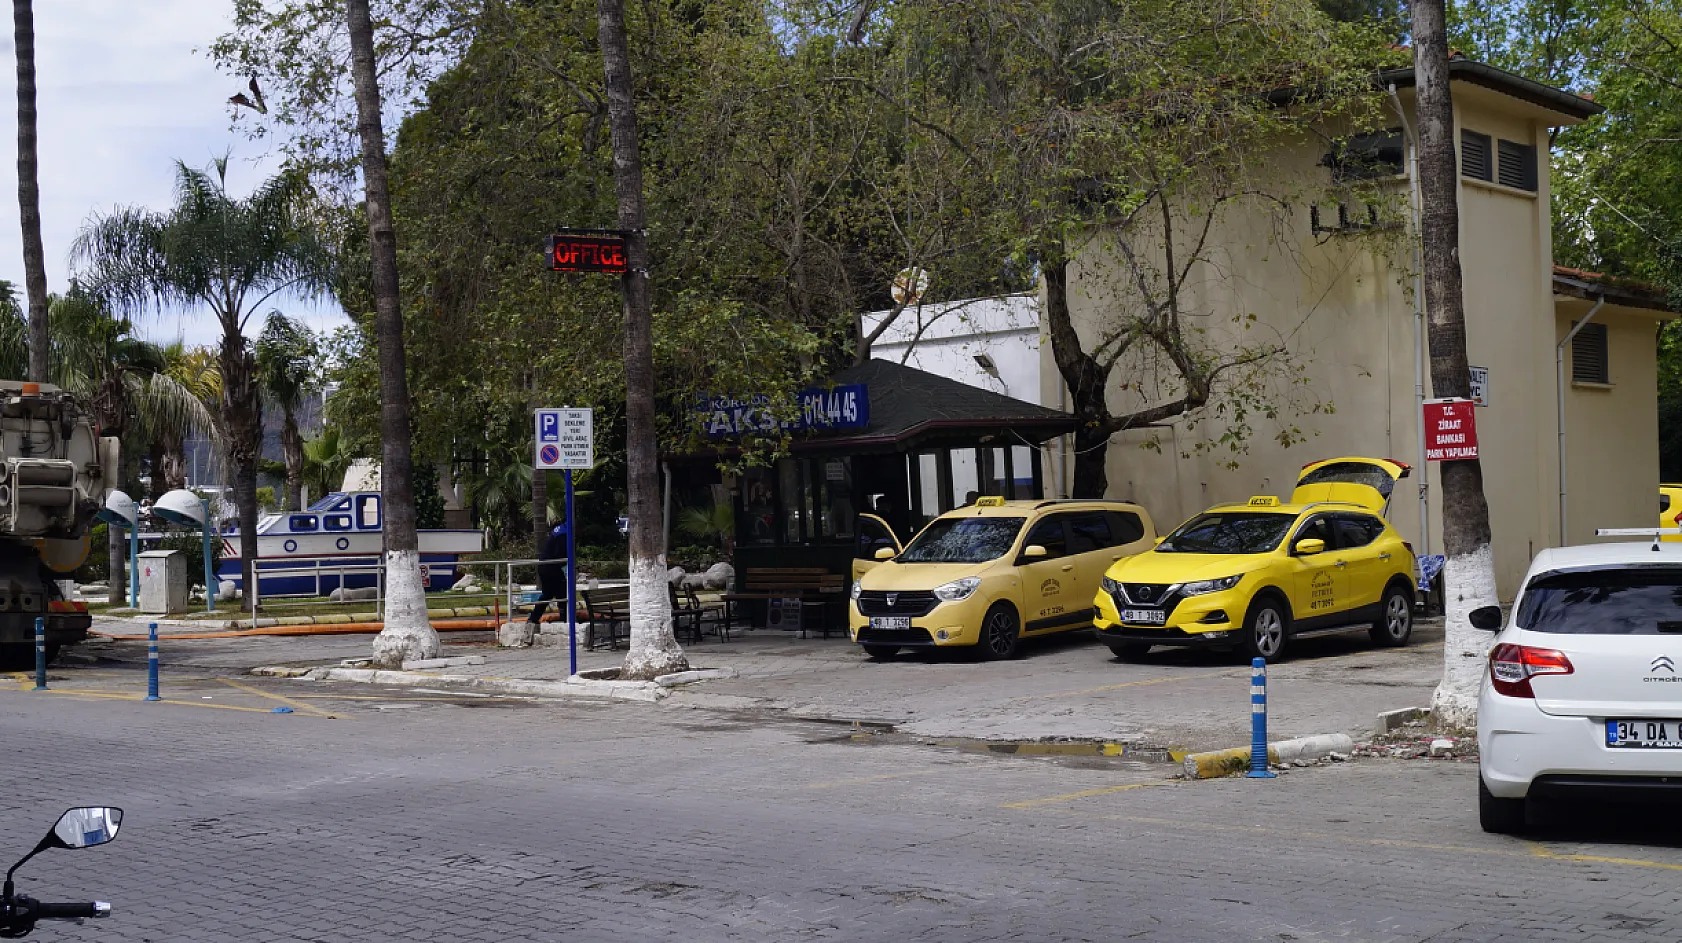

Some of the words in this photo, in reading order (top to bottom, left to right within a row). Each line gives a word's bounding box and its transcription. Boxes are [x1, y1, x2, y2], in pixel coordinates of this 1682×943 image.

[556, 242, 624, 266] OFFICE
[804, 394, 825, 425] 614
[827, 391, 841, 423] 44
[842, 391, 858, 423] 45
[1427, 448, 1445, 459] PARK
[1444, 446, 1478, 458] YAPILMAZ
[1618, 722, 1639, 740] 34
[1647, 722, 1668, 741] DA
